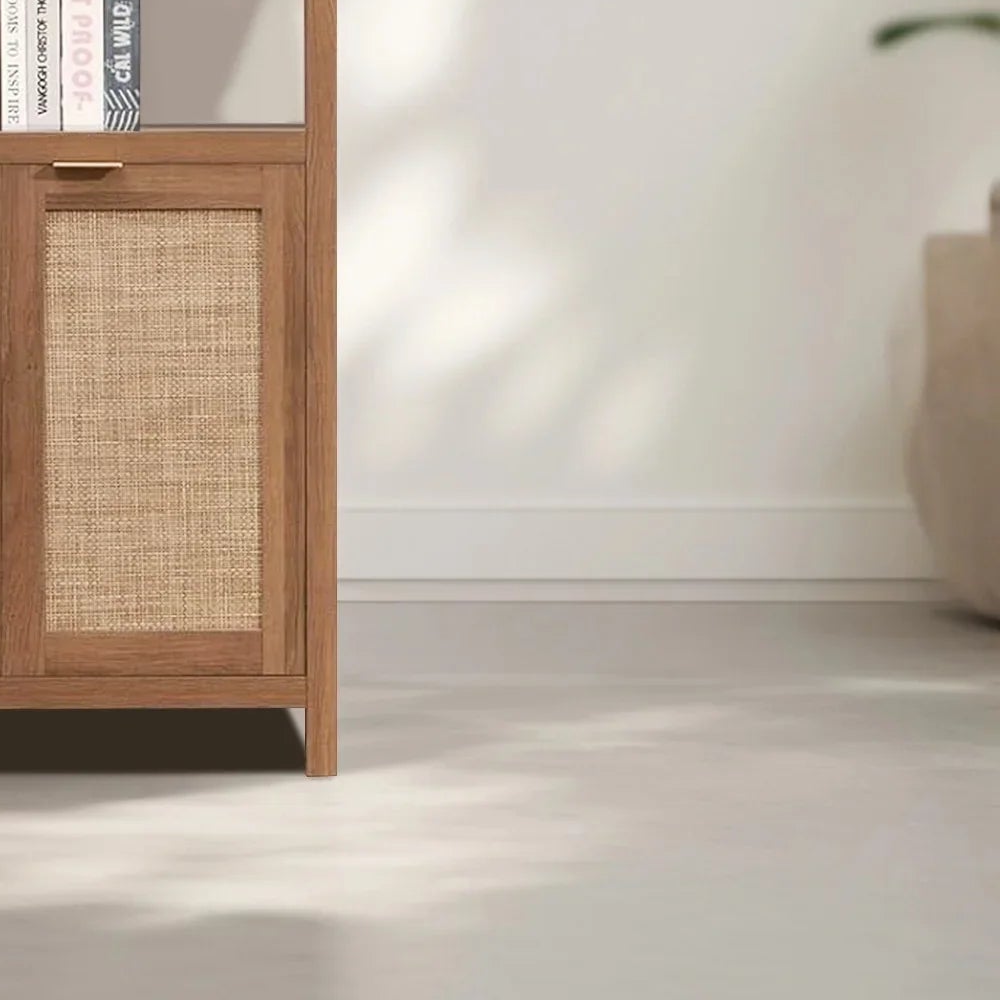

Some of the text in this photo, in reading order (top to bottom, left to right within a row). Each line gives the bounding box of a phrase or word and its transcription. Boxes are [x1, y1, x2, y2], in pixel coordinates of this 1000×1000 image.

[7, 40, 19, 57] TO
[36, 18, 47, 63] CHRISTOF
[7, 64, 20, 124] INSPIRE
[36, 65, 48, 115] VANGOGH
